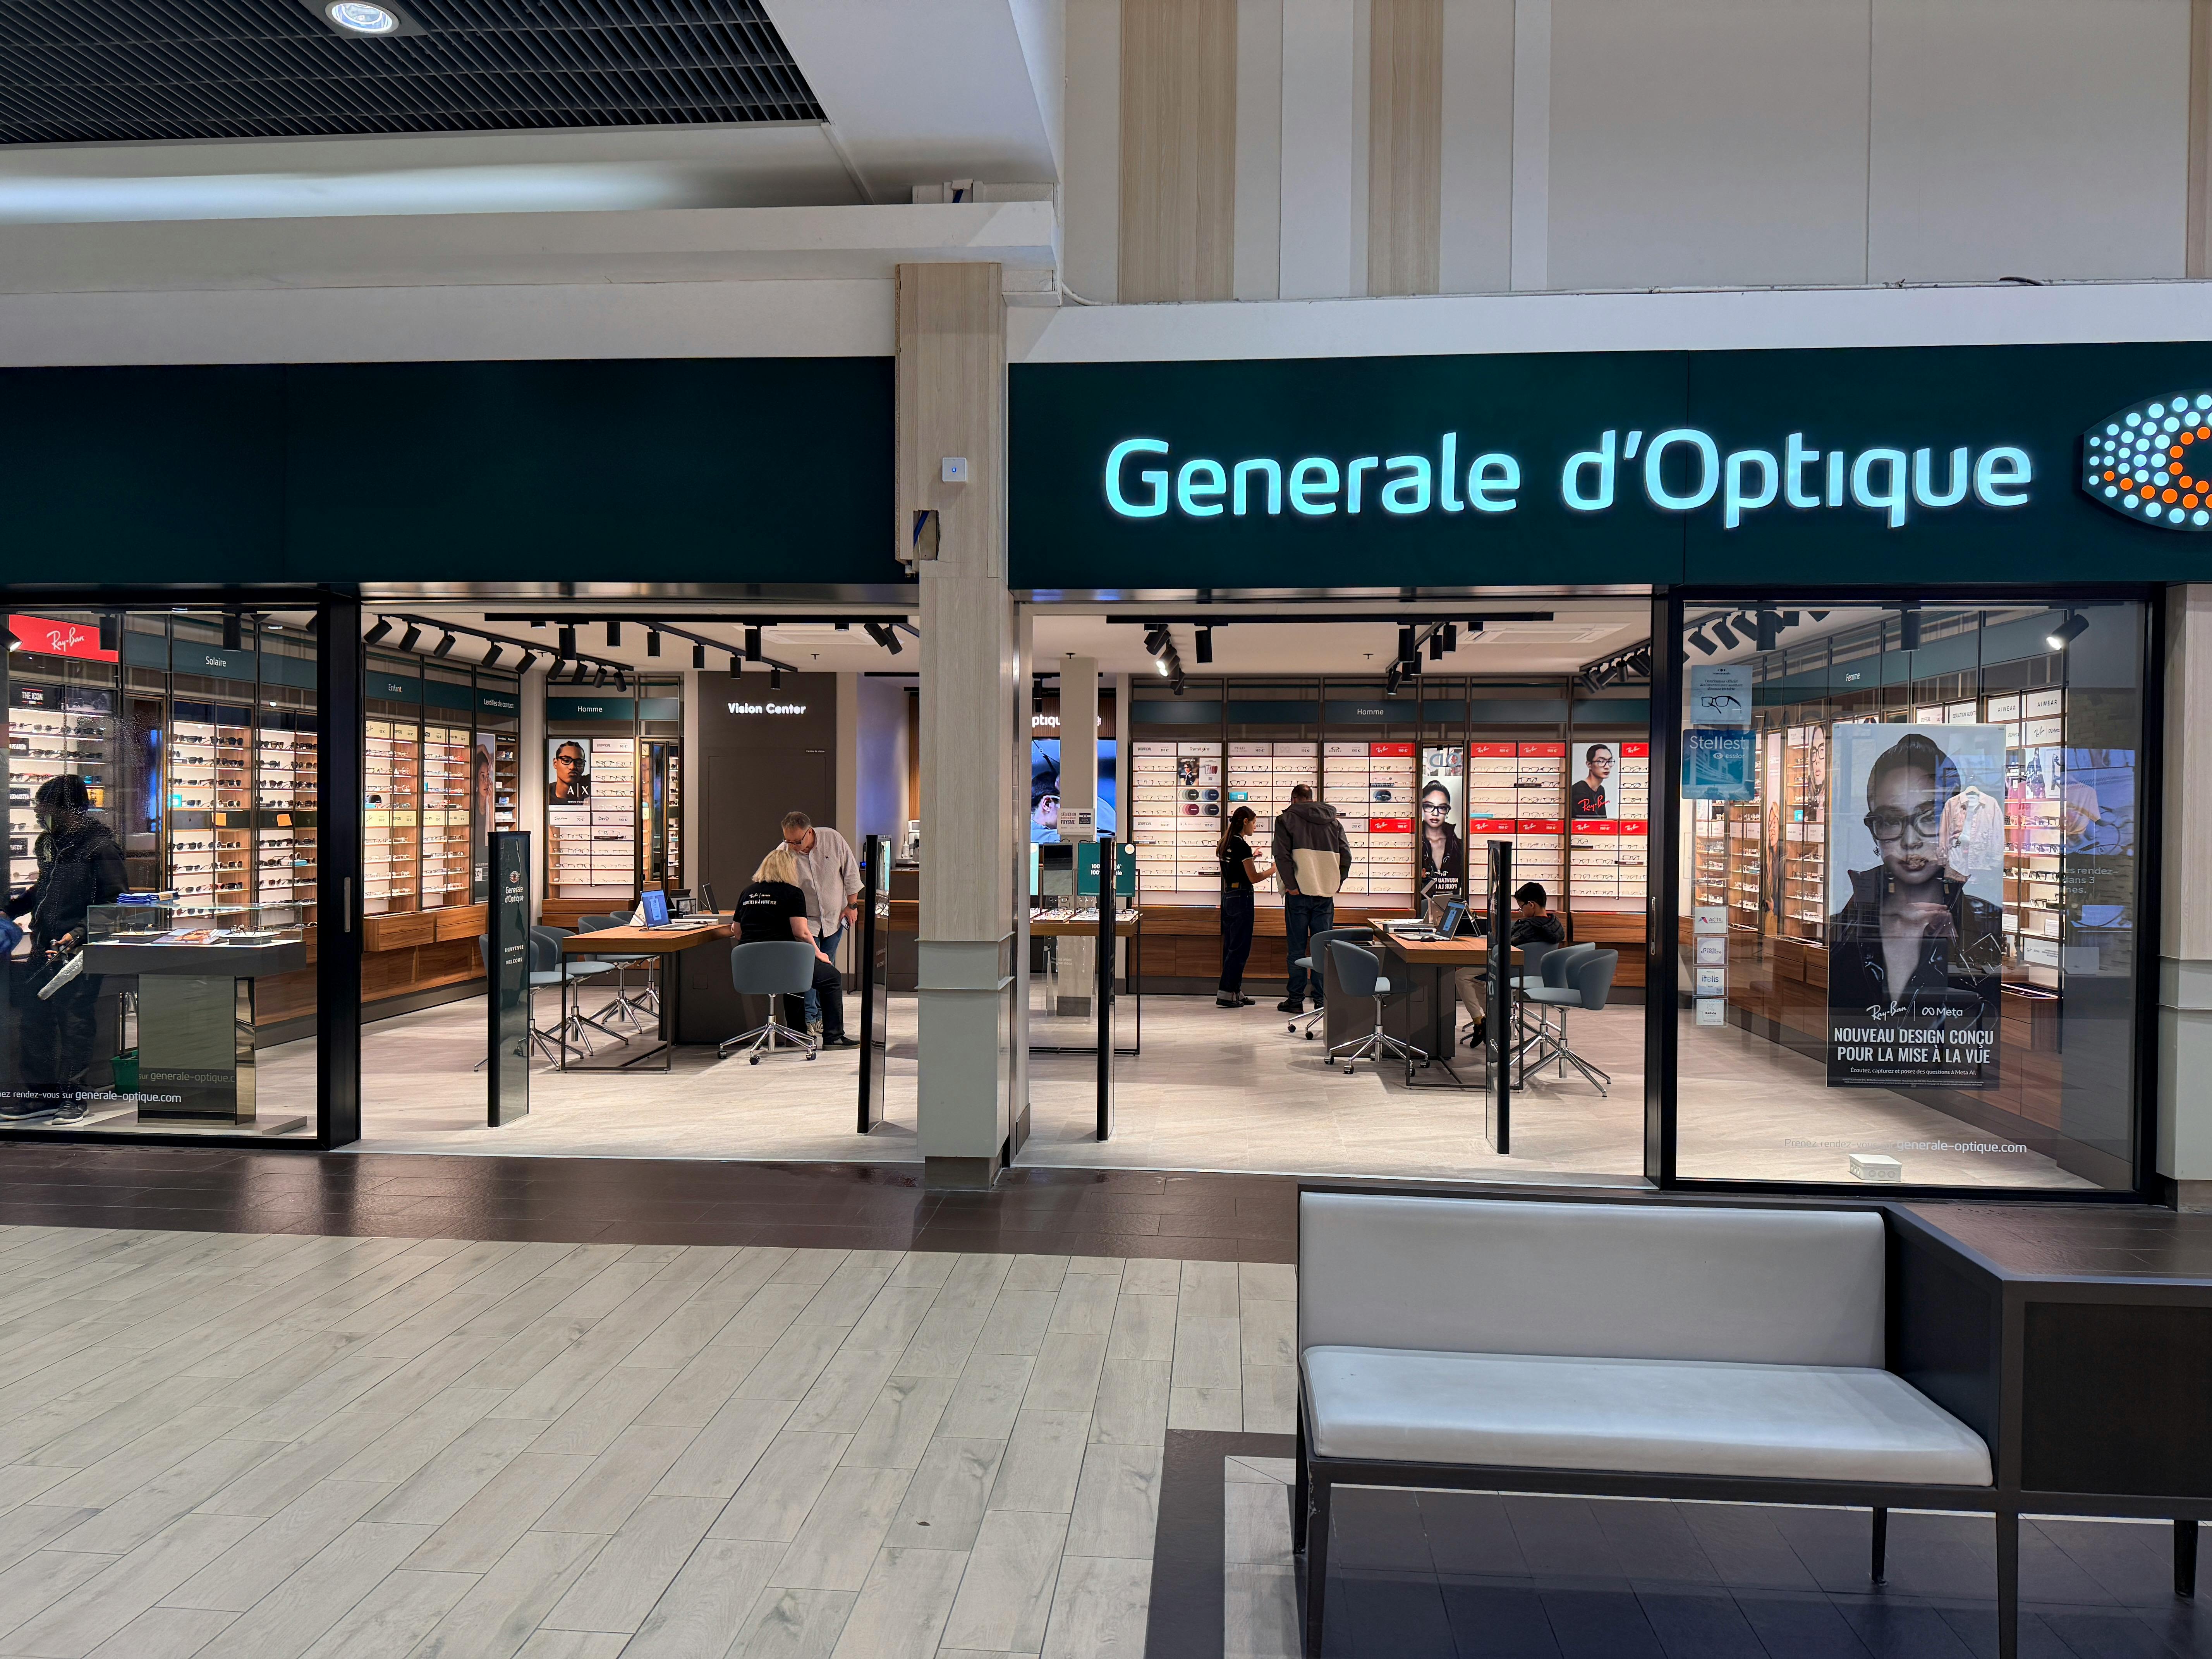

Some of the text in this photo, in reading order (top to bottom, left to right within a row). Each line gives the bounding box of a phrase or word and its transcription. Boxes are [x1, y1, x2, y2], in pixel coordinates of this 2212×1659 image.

[1104, 428, 2032, 529] Generale d'Optique
[206, 656, 226, 667] Solaire
[1846, 673, 1860, 682] Femme
[388, 684, 402, 693] Enfant
[22, 691, 43, 701] THE ICON
[728, 703, 806, 714] Vision Center
[1690, 735, 1745, 749] Stellest
[1578, 795, 1611, 812] Ray-Ban
[505, 885, 523, 894] Generale
[505, 895, 524, 903] d'Optique
[1866, 1000, 1963, 1021] Ray-Ban Meta
[1834, 1027, 1994, 1048] NOUVEAU DESIGN CONÇU
[1837, 1044, 1990, 1064] POUR LA MISE À LA VUE
[75, 1090, 182, 1103] generale-optique.com
[1785, 1139, 1817, 1147] Prenez
[1820, 1140, 1877, 1148] rendez-vous
[1897, 1140, 2027, 1153] generale-optique.com
